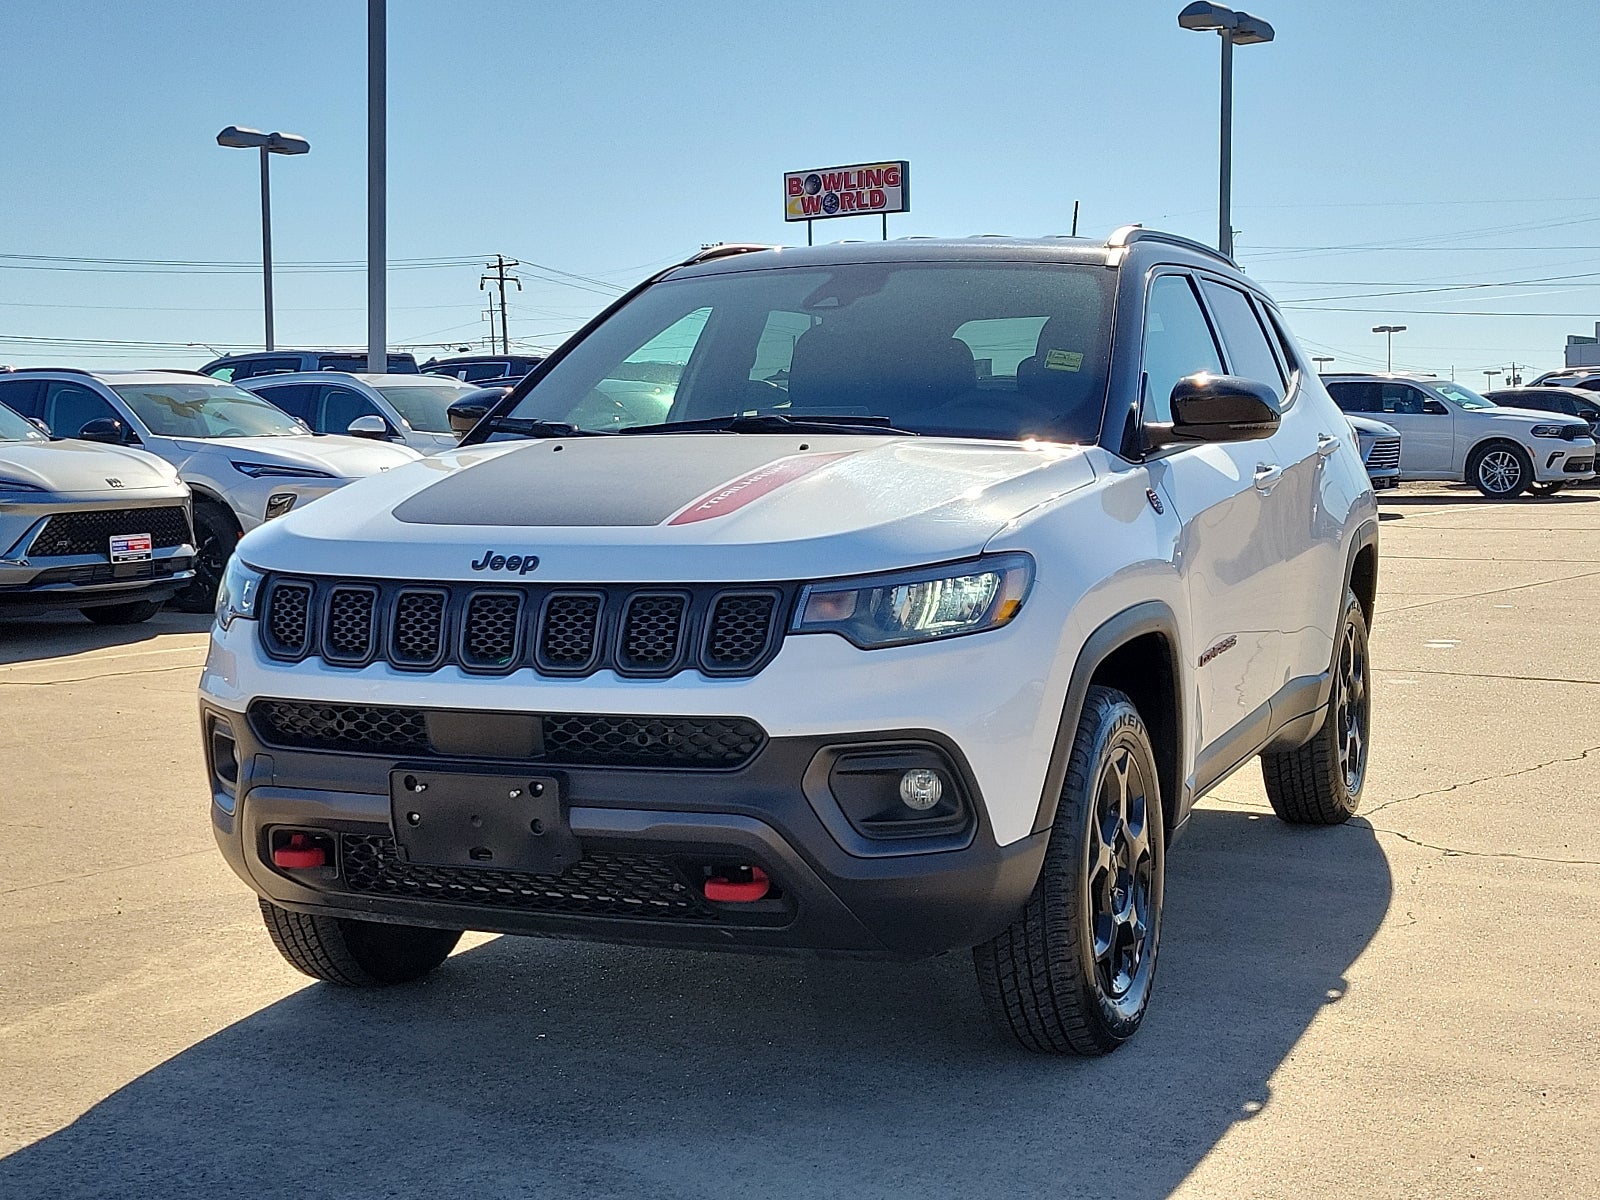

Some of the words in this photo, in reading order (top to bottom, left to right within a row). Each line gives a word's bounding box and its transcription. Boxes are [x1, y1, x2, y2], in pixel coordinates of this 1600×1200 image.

[788, 167, 900, 196] BOWLING
[801, 189, 887, 215] WORLD
[471, 550, 540, 575] Jeep
